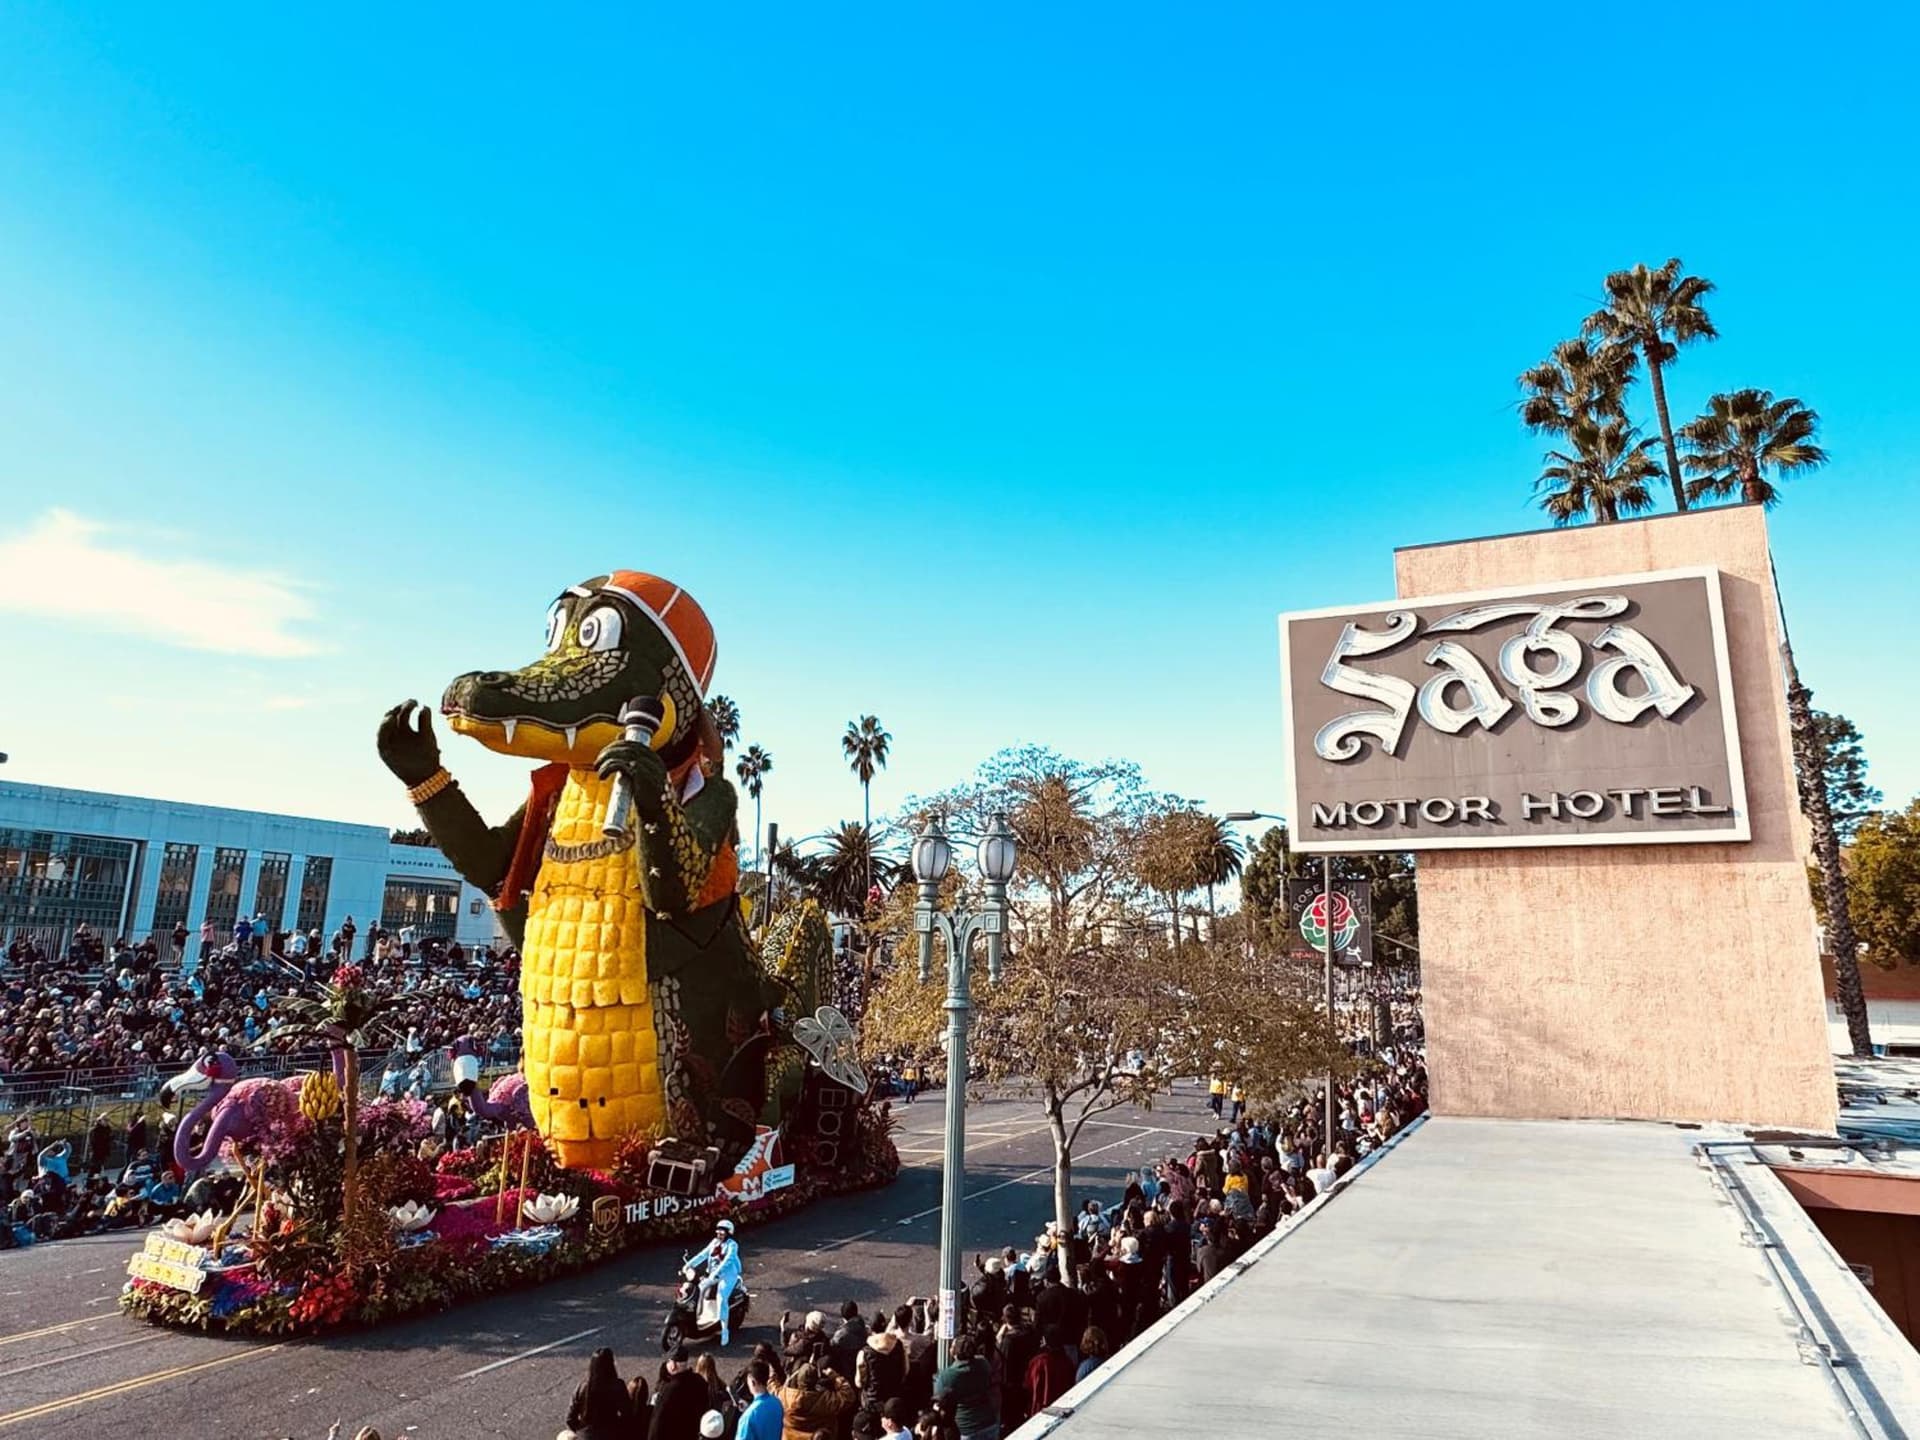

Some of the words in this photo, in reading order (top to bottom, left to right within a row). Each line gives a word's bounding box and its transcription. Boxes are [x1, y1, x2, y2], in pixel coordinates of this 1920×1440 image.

[1311, 797, 1495, 828] MOTOR
[1522, 785, 1729, 819] HOTEL
[1292, 884, 1322, 912] ROSE
[624, 1200, 650, 1223] THE
[654, 1196, 679, 1216] UPS
